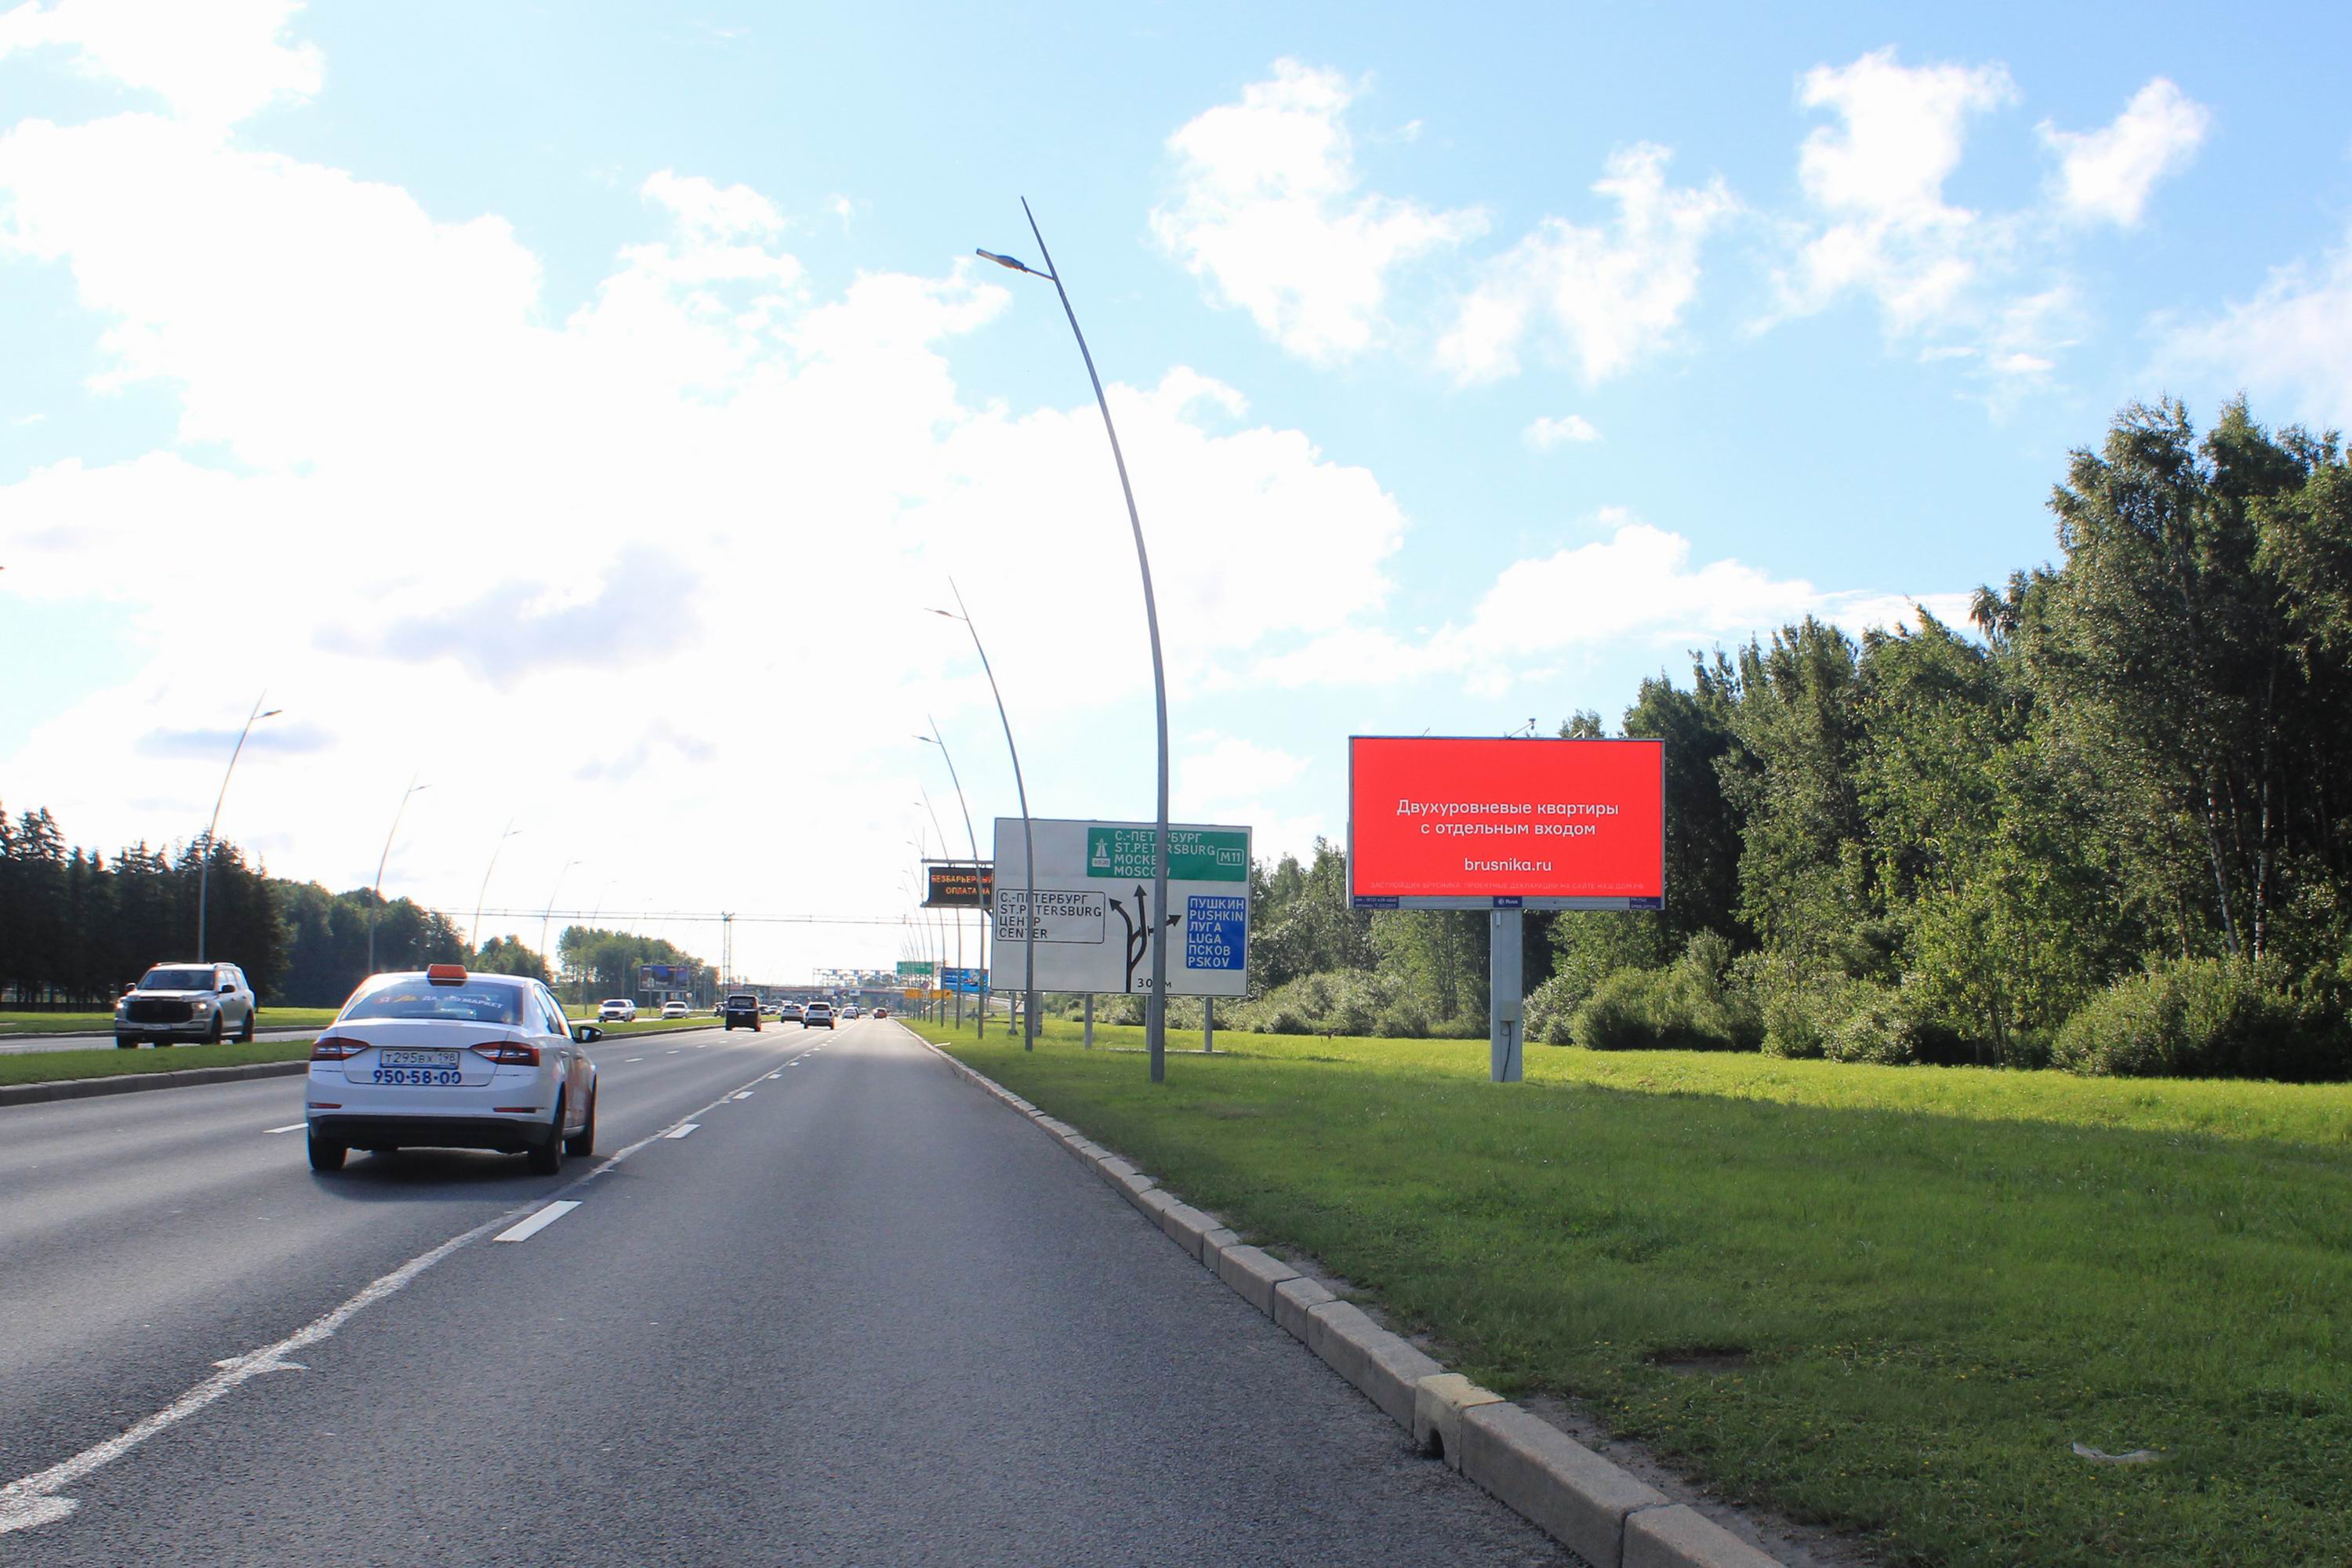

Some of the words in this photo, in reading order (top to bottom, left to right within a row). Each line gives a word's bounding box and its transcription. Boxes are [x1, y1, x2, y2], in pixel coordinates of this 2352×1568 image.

[1396, 799, 1532, 816] Двухуровневые
[1537, 804, 1619, 818] квартиры
[1421, 824, 1430, 834] с
[1435, 823, 1529, 837] отдельным
[1534, 824, 1595, 837] входом
[1115, 831, 1202, 844] С.-ПЕТБУРГ
[1114, 842, 1216, 856] ST.PETRSBURG
[1220, 852, 1240, 863] M11
[1464, 858, 1552, 872] brusnika.ru
[1113, 866, 1171, 877] MOSCO
[1000, 892, 1088, 905] С.-ПТЕРБУРГ
[1190, 898, 1244, 910] ПУШКИН
[1000, 904, 1102, 917] ST.PTERSBURG
[1189, 909, 1243, 922] PUSHKIN
[1000, 916, 1041, 927] ЦЕНР
[1189, 921, 1222, 933] ЛУГА
[999, 927, 1048, 939] CENER
[1189, 934, 1221, 945] LUGA
[1189, 945, 1231, 956] ПСКОВ
[1188, 956, 1229, 967] PSKOV
[1137, 978, 1156, 989] 30
